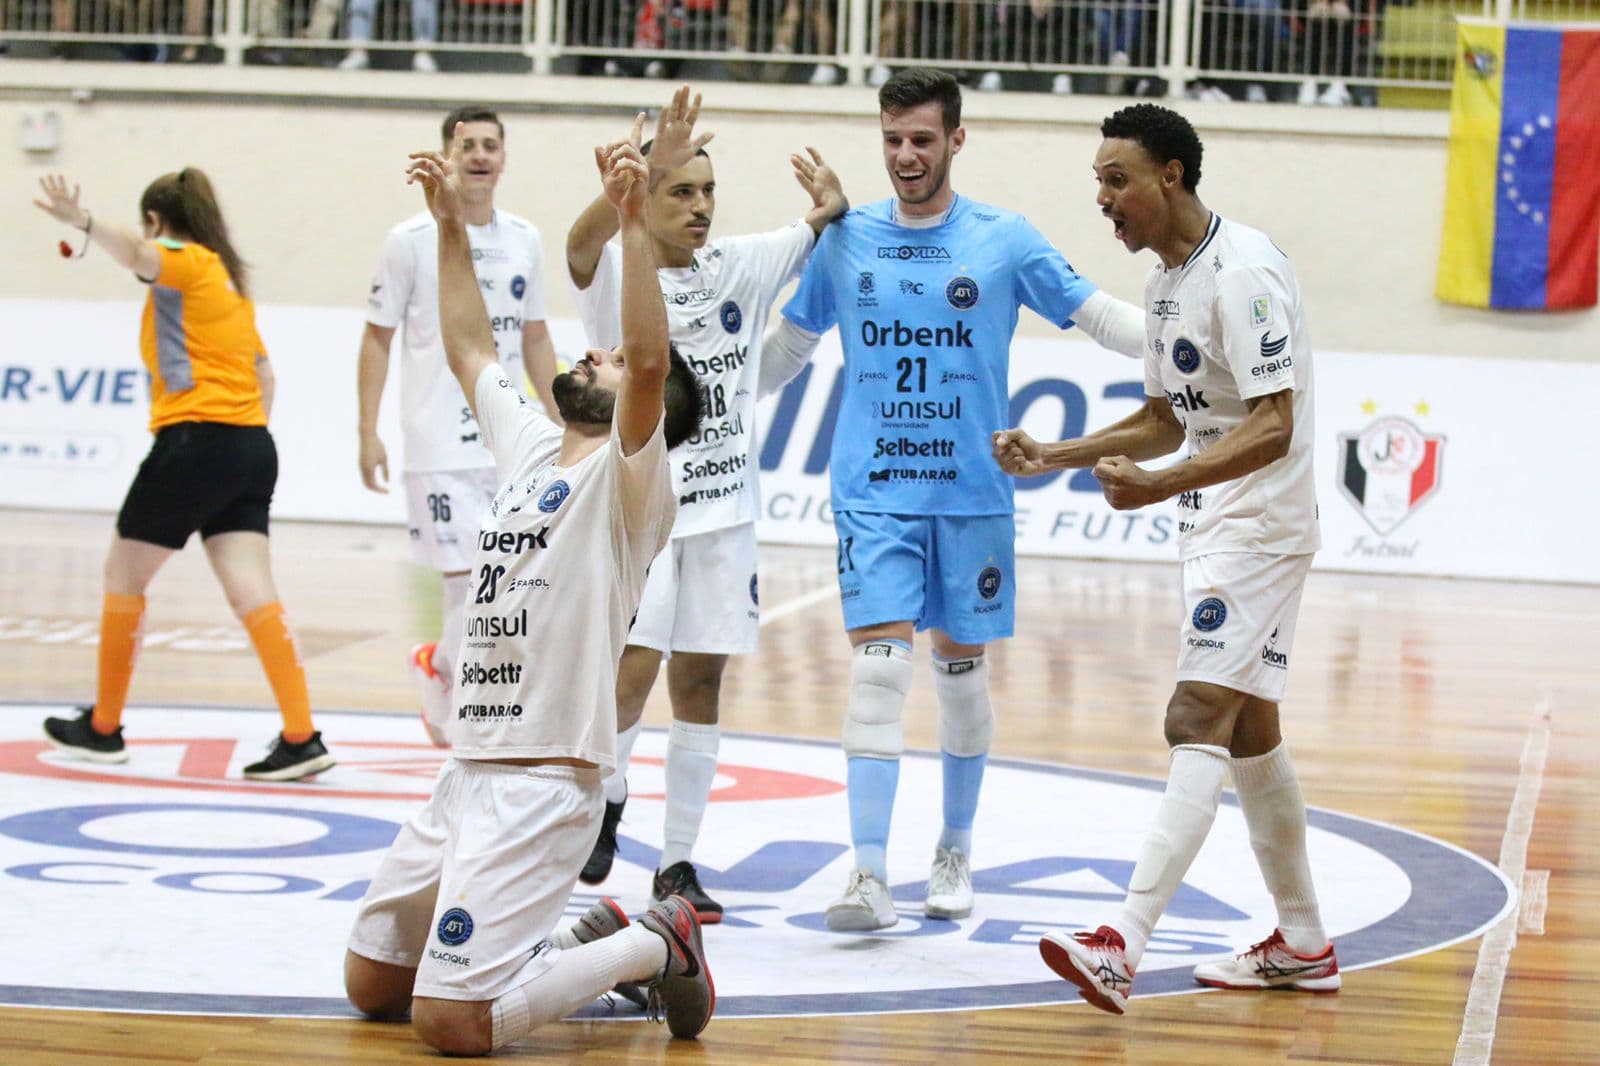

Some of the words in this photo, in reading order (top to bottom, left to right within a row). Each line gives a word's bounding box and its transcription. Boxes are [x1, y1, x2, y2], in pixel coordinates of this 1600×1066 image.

[878, 245, 951, 260] PROVIDA
[862, 319, 973, 348] Orbenk
[864, 372, 888, 380] FAROL
[896, 356, 927, 393] 21
[948, 373, 977, 381] FAROL
[1251, 355, 1292, 376] erald
[704, 383, 727, 419] 18
[881, 396, 961, 420] unisul
[873, 437, 955, 459] Selbetti
[892, 466, 957, 481] TUBARÃO
[1051, 509, 1173, 545] FUTS
[517, 578, 550, 587] FAROL
[467, 608, 528, 638] unisul
[461, 661, 523, 688] Selbetti
